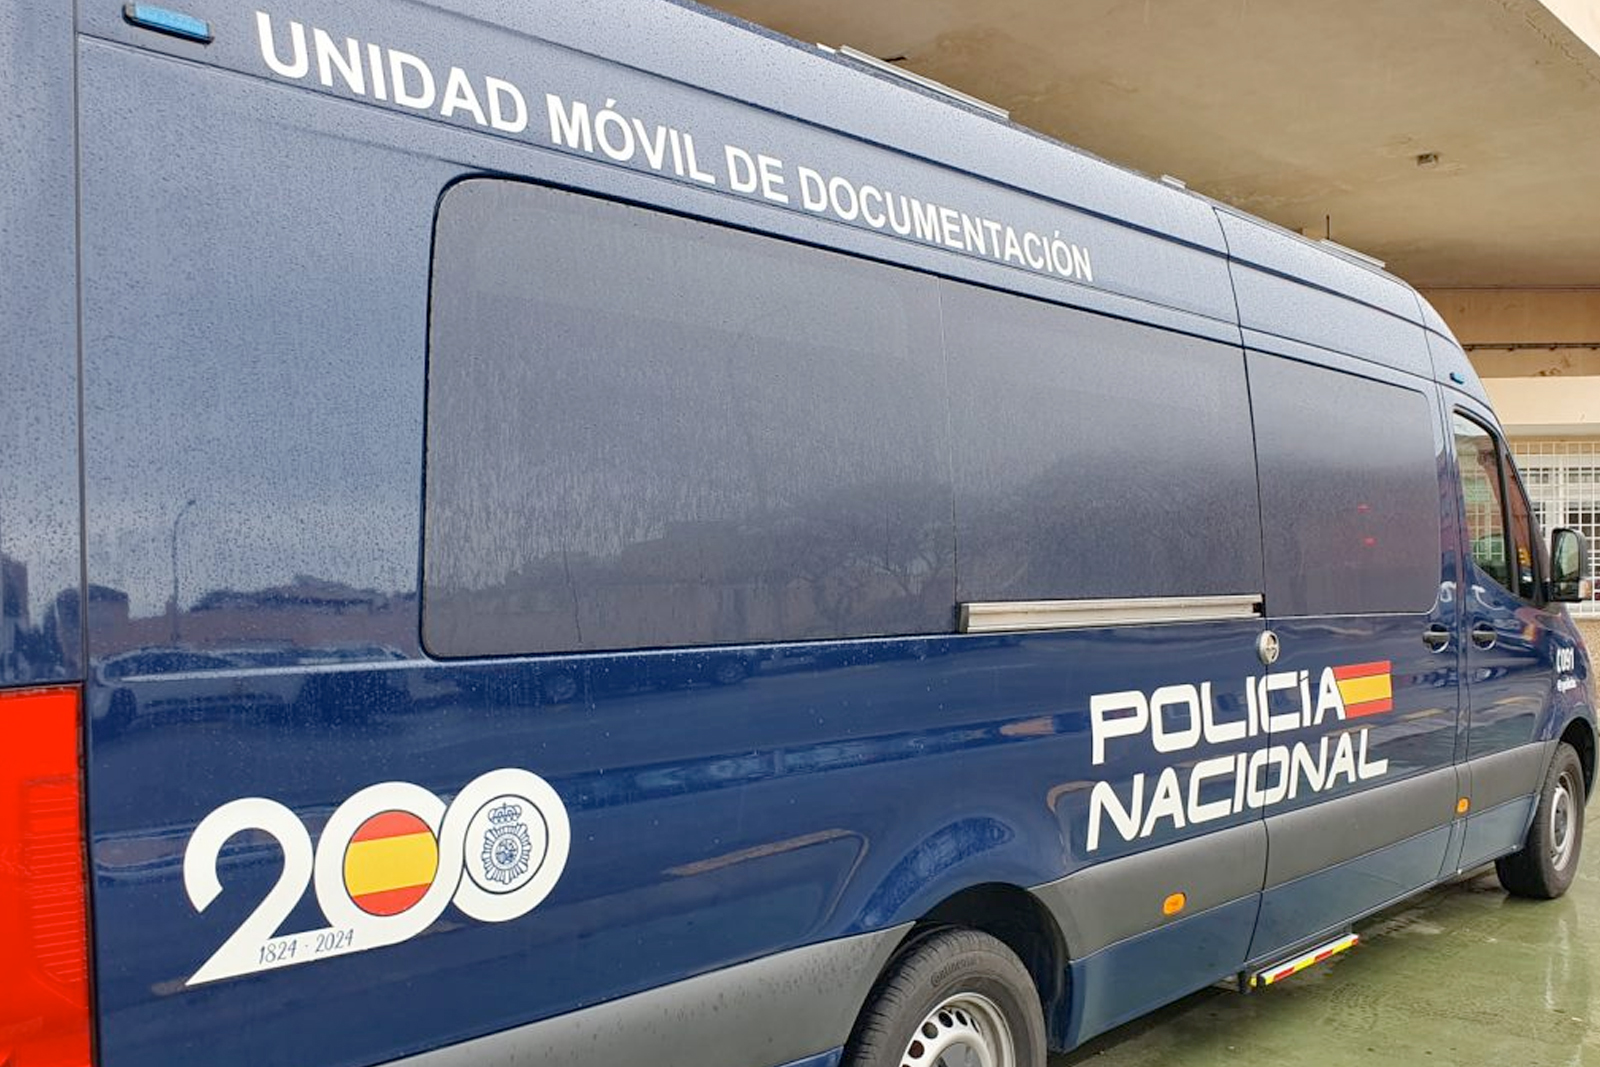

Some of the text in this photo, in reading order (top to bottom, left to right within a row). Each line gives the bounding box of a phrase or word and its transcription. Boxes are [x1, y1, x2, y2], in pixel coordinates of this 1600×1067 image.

[255, 10, 1094, 283] UNIDAD MÓVIL DE DOCUMENTACIÓN
[1086, 728, 1389, 851] NACIONAL
[183, 767, 571, 987] 200
[258, 939, 298, 965] 1824
[314, 928, 354, 954] 2024
